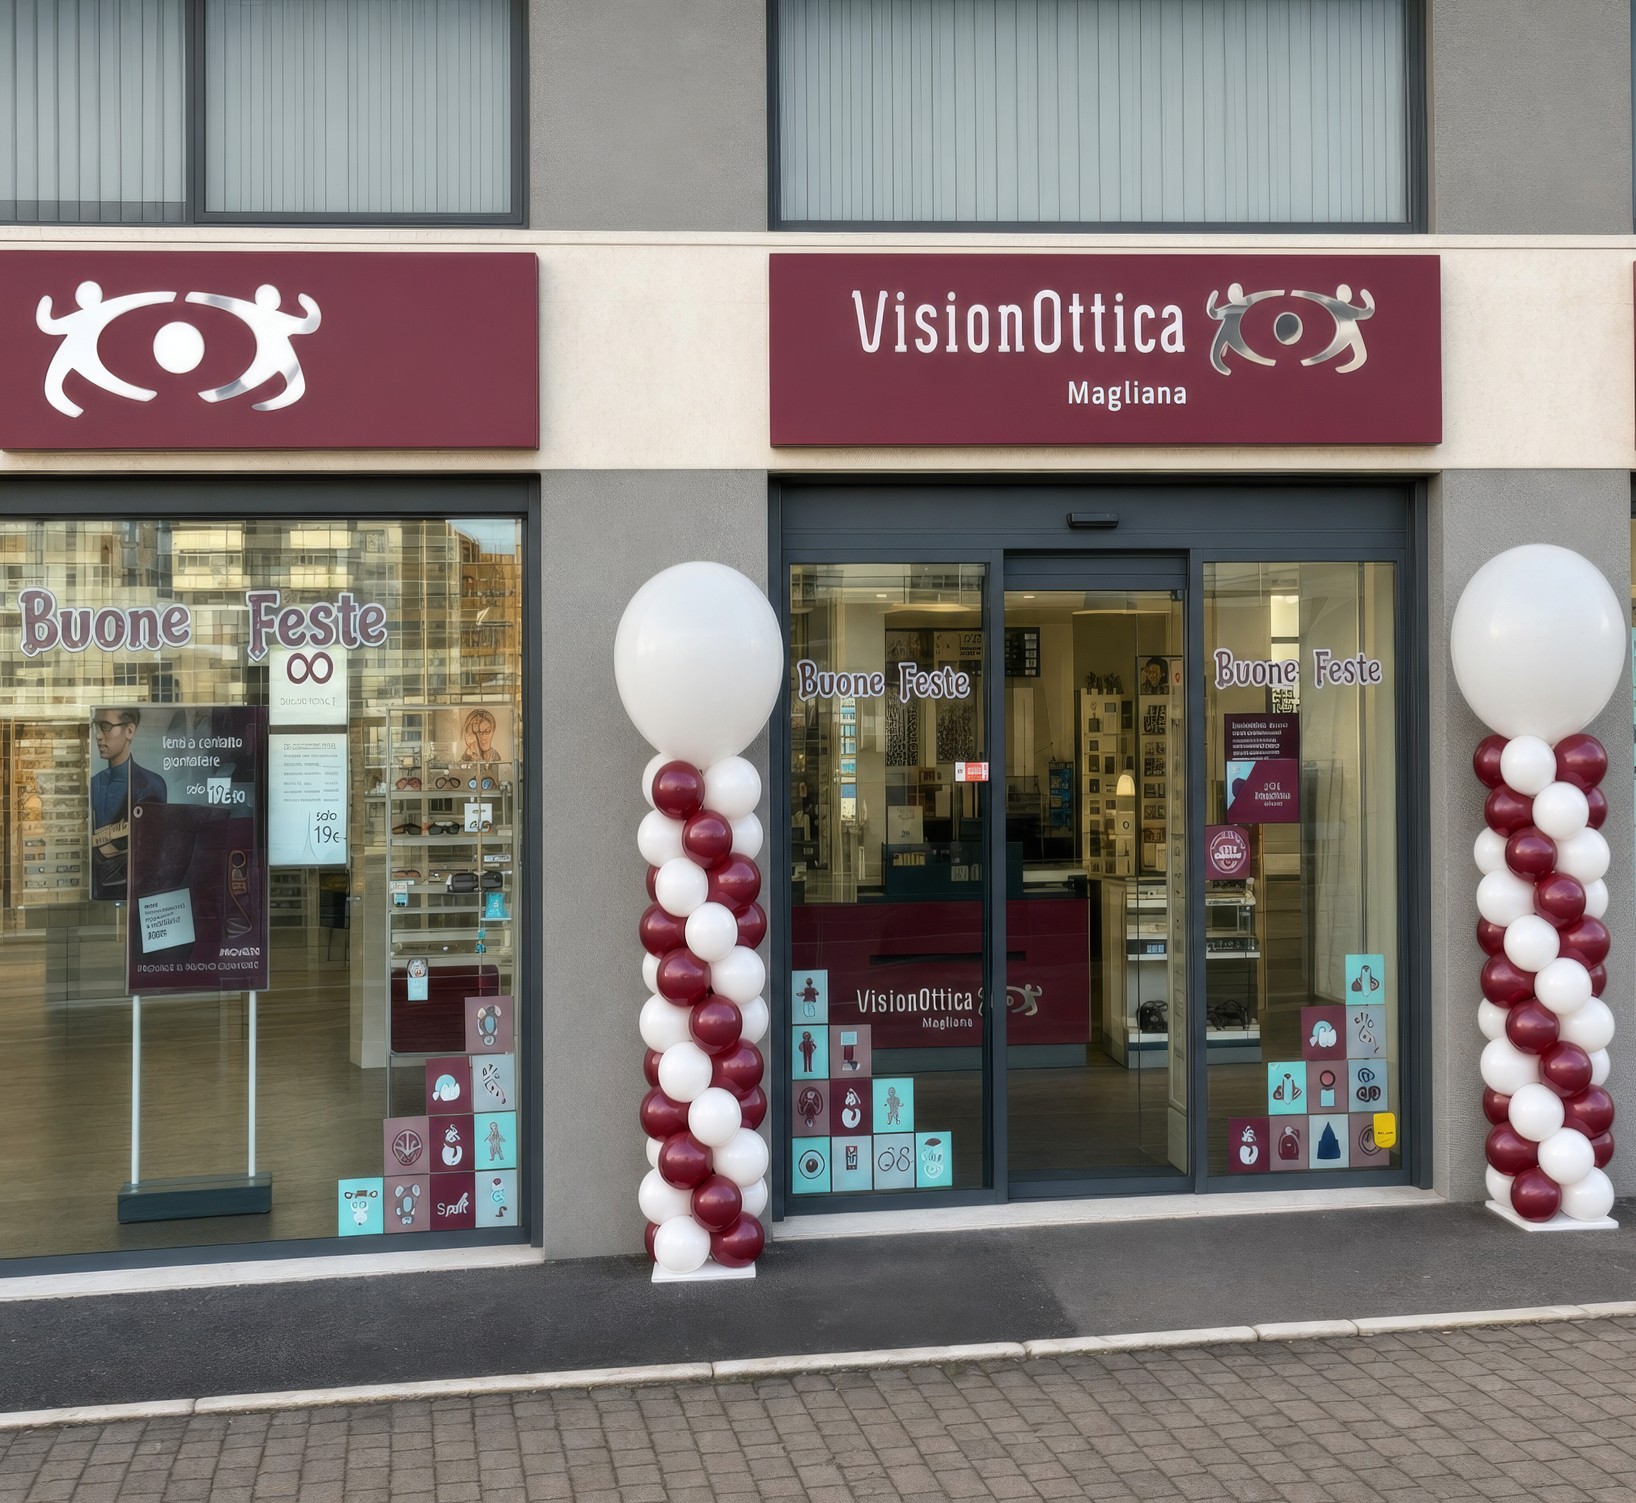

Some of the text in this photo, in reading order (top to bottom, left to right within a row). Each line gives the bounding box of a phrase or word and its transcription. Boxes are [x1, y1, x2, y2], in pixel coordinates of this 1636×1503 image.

[852, 289, 1186, 354] VisionOttica
[1067, 380, 1187, 412] Magliana
[18, 586, 389, 662] Buone Feste
[796, 659, 971, 704] Buone Feste
[1213, 648, 1383, 690] Buone Feste
[856, 988, 973, 1014] VisionOttica
